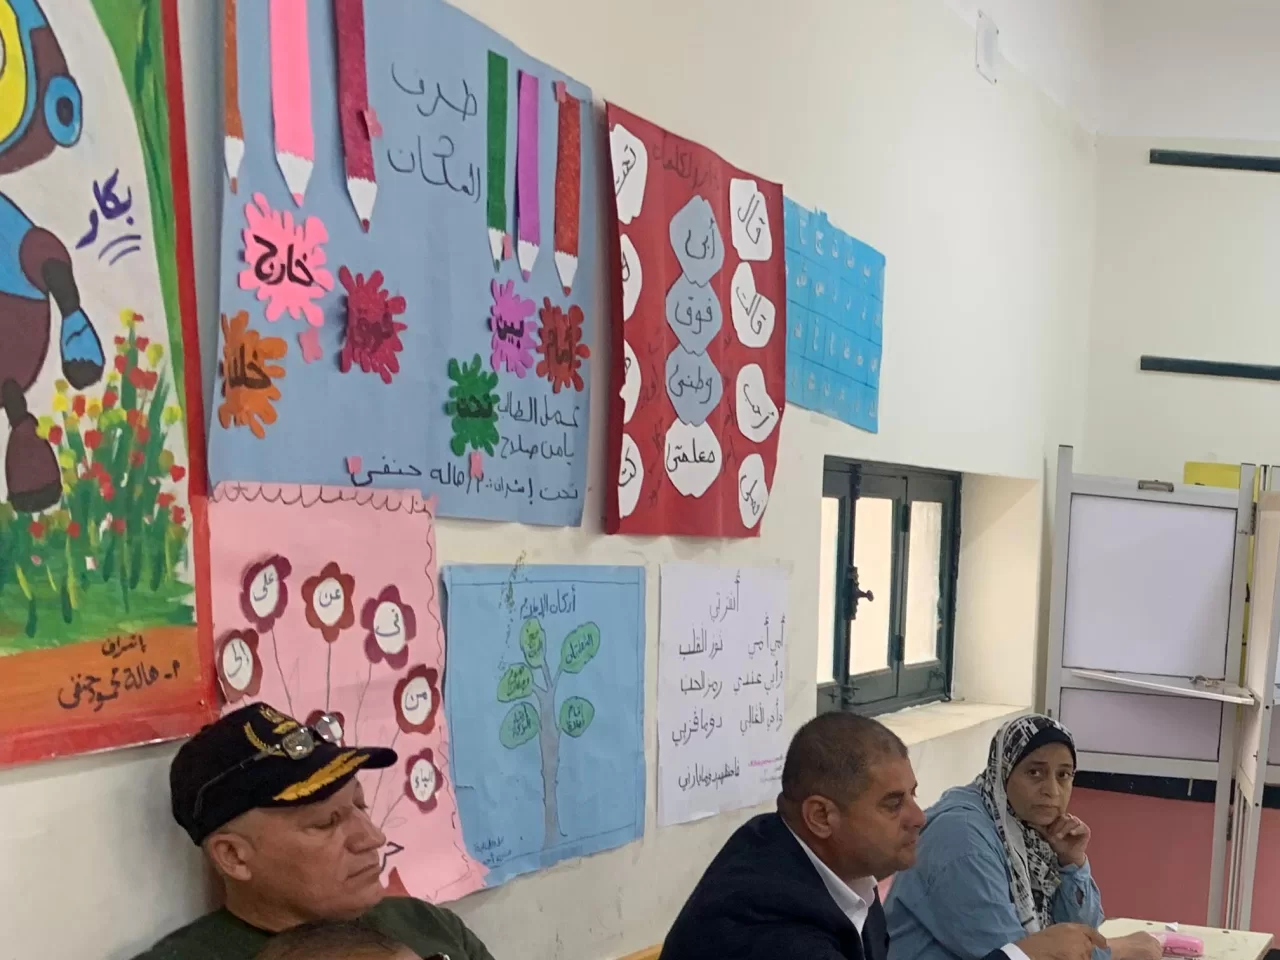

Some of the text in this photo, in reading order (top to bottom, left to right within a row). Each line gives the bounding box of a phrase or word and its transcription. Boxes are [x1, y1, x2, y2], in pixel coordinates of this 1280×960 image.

[737, 192, 766, 246] قال
[252, 233, 315, 287] خارج
[674, 295, 713, 335] فوق
[253, 572, 274, 602] على
[318, 587, 341, 607] عن
[123, 661, 159, 691] هالة
[405, 691, 428, 711] من
